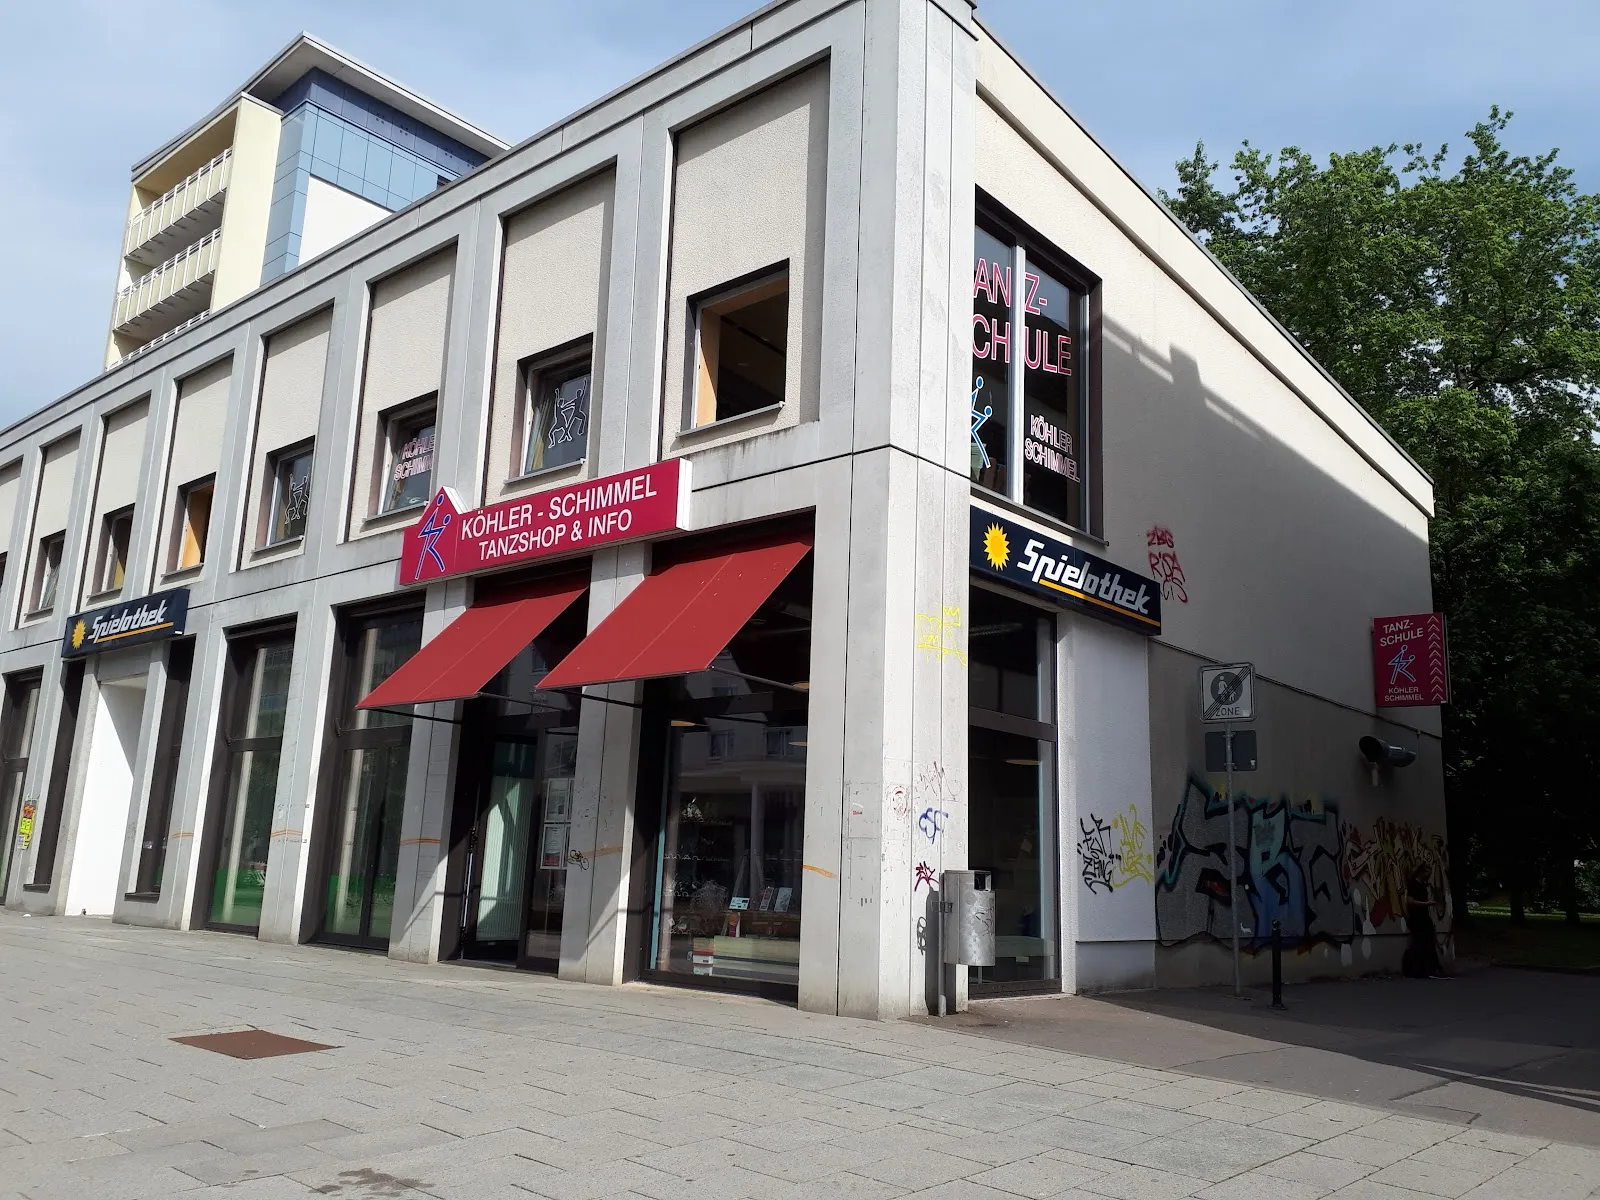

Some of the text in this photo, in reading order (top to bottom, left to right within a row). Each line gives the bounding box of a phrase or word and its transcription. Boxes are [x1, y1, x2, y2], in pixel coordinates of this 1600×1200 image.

[973, 257, 1047, 315] ANZ-
[972, 313, 1071, 376] CHULE
[402, 434, 436, 460] KÖHLE
[1030, 414, 1073, 455] KÖHLER
[1024, 437, 1081, 483] SCHIMMEL
[461, 502, 532, 540] KÖHLER
[549, 473, 657, 521] SCHIMMEL
[478, 509, 633, 561] TANZSHOP & INFO
[1016, 538, 1151, 615] Spielothek
[87, 599, 168, 644] Spielothek
[1380, 627, 1424, 647] SCHULE
[1383, 619, 1414, 634] TANZ-
[1384, 693, 1425, 702] SCHIMMEL
[1388, 685, 1419, 694] KÖHLER
[1215, 706, 1241, 717] ZONE
